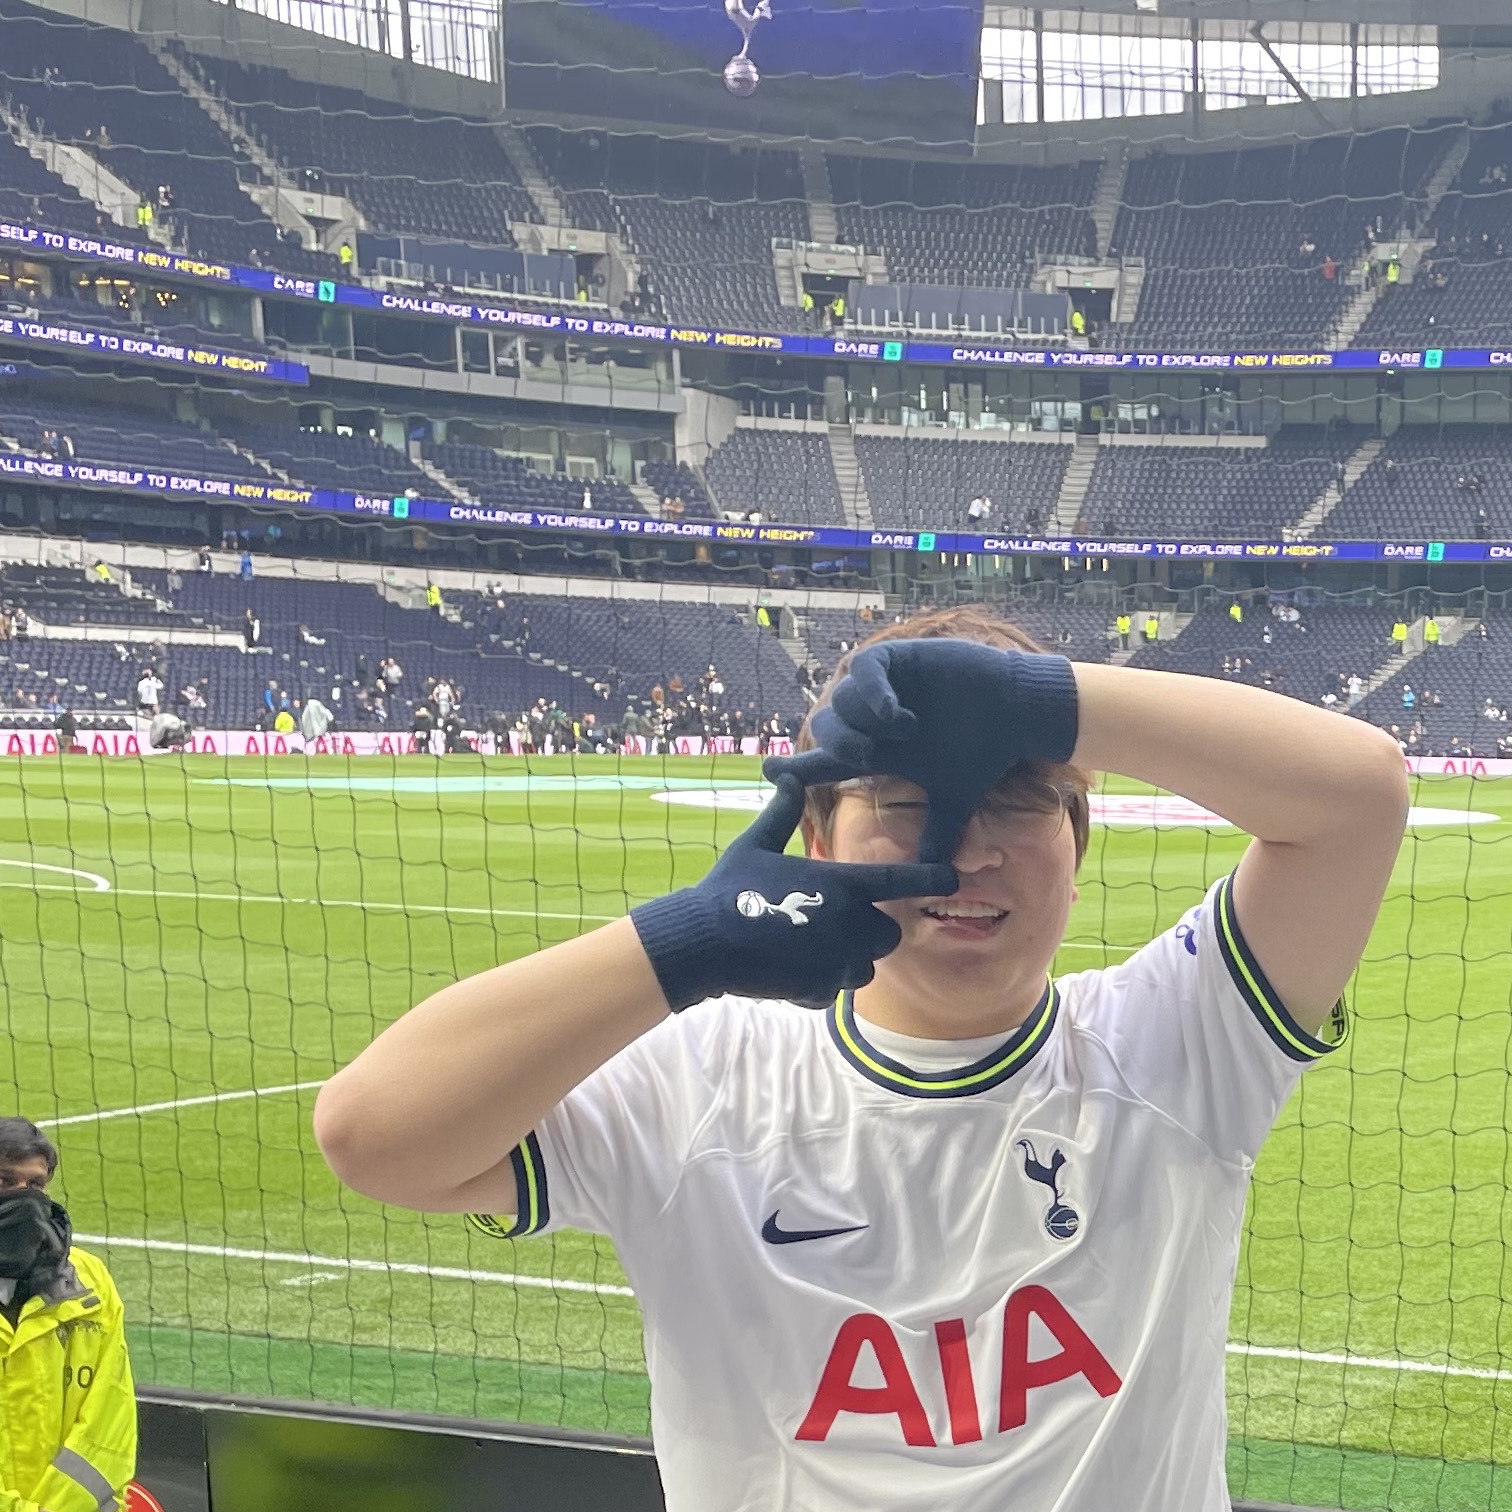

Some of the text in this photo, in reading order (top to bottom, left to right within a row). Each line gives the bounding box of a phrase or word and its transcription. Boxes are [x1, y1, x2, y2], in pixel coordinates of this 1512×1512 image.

[43, 232, 64, 248] TO
[68, 235, 134, 261] EXPLORE
[138, 251, 171, 268] NEW
[382, 294, 472, 318] CHALLENGE
[477, 307, 560, 328] YOURSELF
[565, 317, 588, 332] TO
[592, 320, 666, 340] EXPLORE
[670, 330, 711, 343] NEW
[18, 322, 95, 346] YOURSELF
[99, 335, 118, 350] TO
[122, 338, 184, 361] EXPLORE
[187, 349, 218, 366] NEW
[953, 349, 1332, 367] CHALLENGE YOURSELF TO EXPLORE NEW HEIGHTS
[68, 466, 143, 486] YOURSELF
[147, 474, 166, 488] TO
[170, 476, 230, 496] EXPLORE
[234, 485, 264, 499] NEW
[450, 506, 532, 524] CHALLENGE
[536, 514, 614, 531] YOURSELF
[619, 518, 639, 532] TO
[644, 521, 712, 537] EXPLORE
[716, 526, 755, 540] NEW
[984, 539, 1071, 552] CHALLENGE
[1076, 541, 1151, 555] YOURSELF
[1156, 543, 1176, 554] TO
[1180, 543, 1242, 555] EXPLORE
[1246, 545, 1278, 556] NEW
[8, 734, 58, 754] AIA
[92, 734, 141, 755] AIA
[246, 735, 287, 754] AIA
[795, 1284, 1122, 1447] AIA
